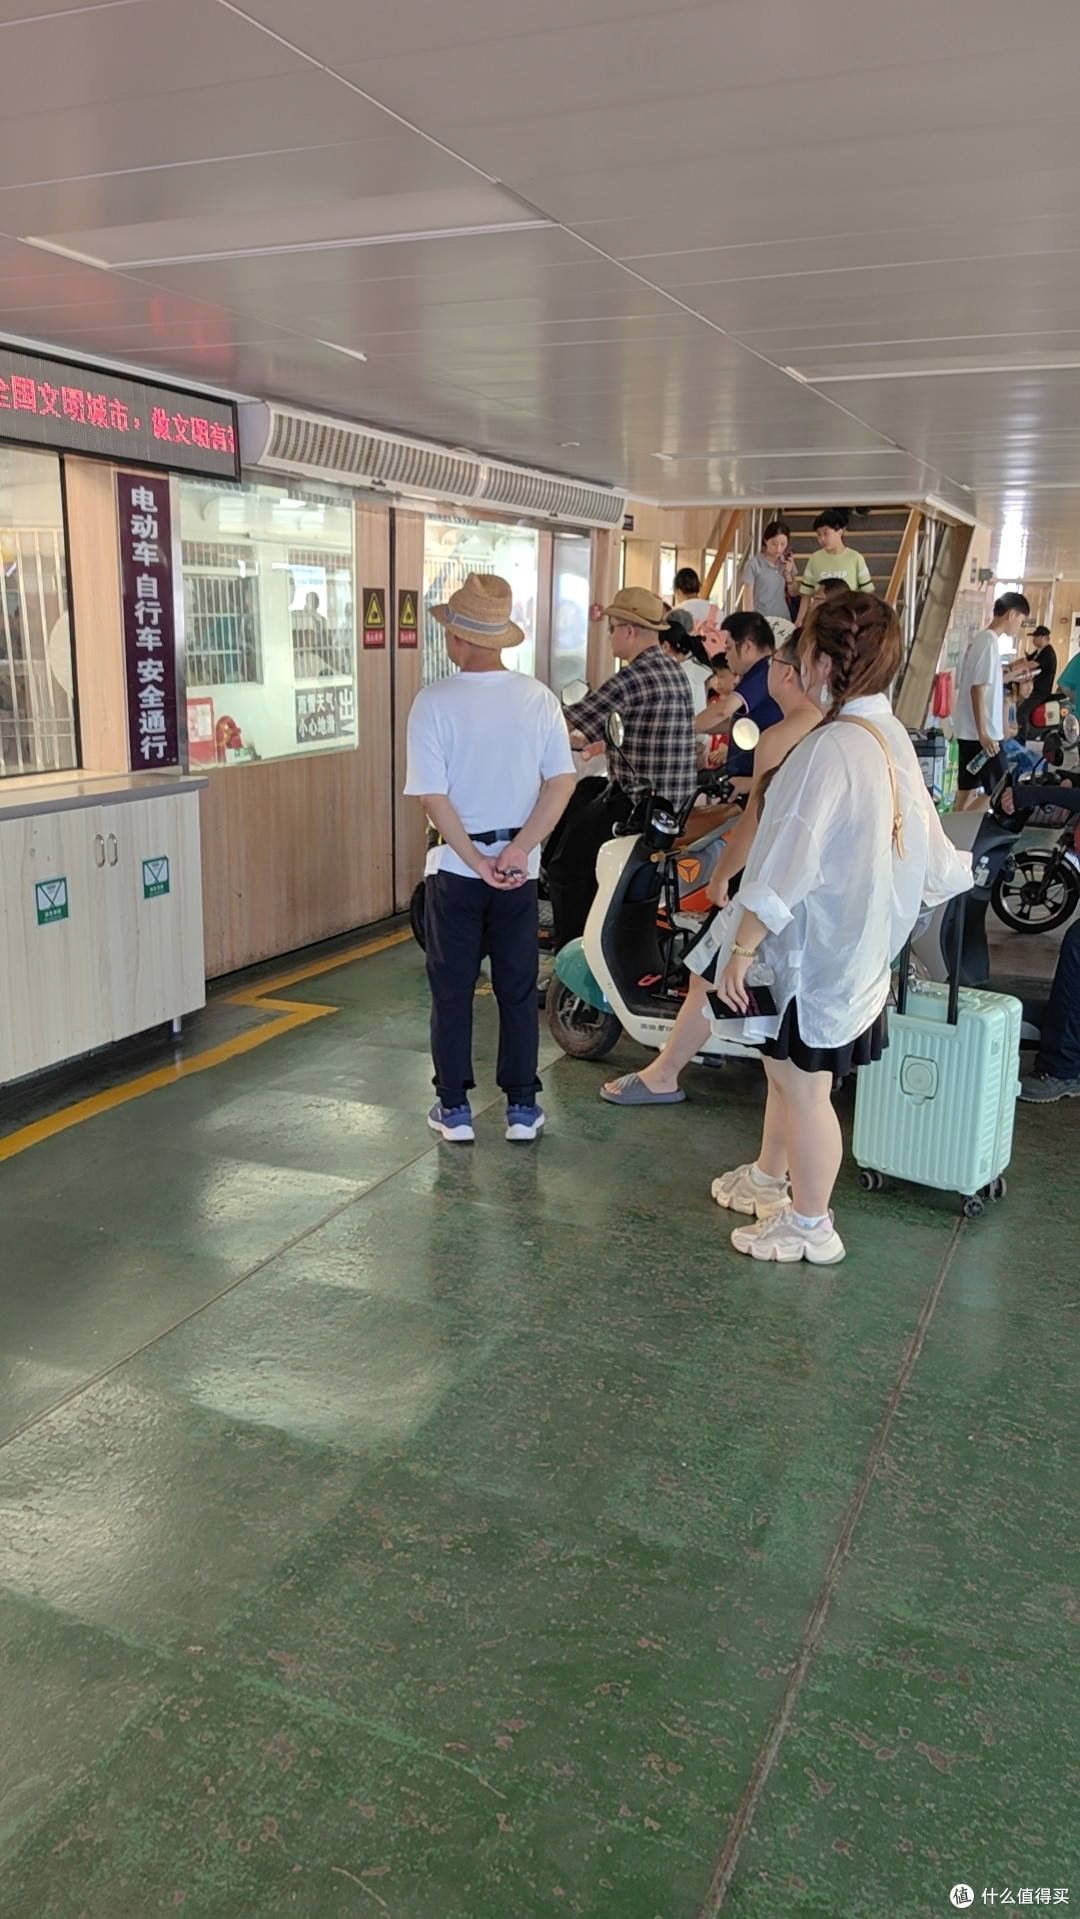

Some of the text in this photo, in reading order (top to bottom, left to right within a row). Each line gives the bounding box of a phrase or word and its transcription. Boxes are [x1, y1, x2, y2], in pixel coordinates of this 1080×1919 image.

[130, 486, 168, 760] 电动车 自行车 安全通行
